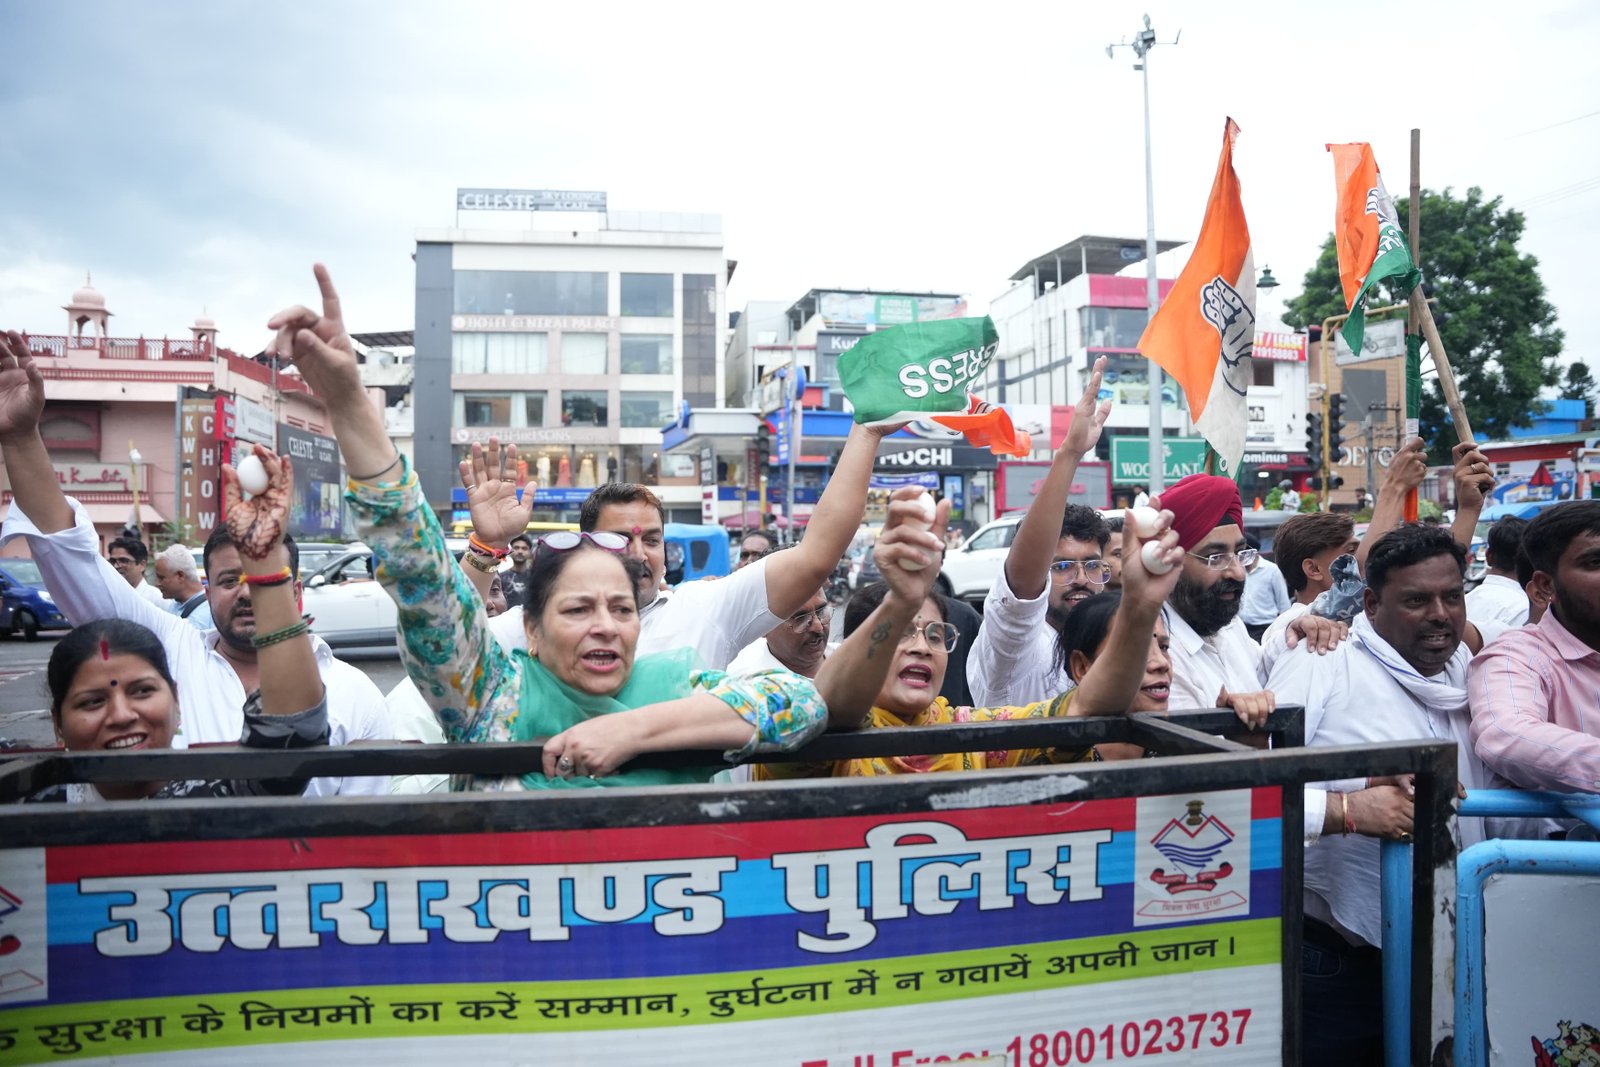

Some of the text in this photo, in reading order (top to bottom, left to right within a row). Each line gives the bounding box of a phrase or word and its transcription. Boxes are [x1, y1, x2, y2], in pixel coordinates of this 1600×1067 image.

[461, 193, 536, 210] CELESTE
[468, 317, 617, 331] HOTEL CENTRAL PALACE
[288, 436, 314, 460] CELESTE
[1241, 452, 1289, 463] ominus
[182, 415, 196, 541] KWALIT
[1121, 461, 1204, 477] WOOLAN
[78, 821, 1113, 957] उत्तराखण्ड पुलिस
[34, 1016, 166, 1055] सुरक्षा
[182, 1003, 226, 1034] के
[239, 995, 374, 1031] नियमों
[390, 1001, 442, 1023] का
[457, 991, 521, 1021] करें
[535, 993, 690, 1020] सम्मान,
[707, 978, 833, 1017] दुर्घटना
[846, 969, 879, 998] में
[894, 971, 924, 992] न
[936, 953, 1031, 987] गवायें
[1045, 941, 1141, 976] अपनी
[1006, 1008, 1252, 1067] 18001023737
